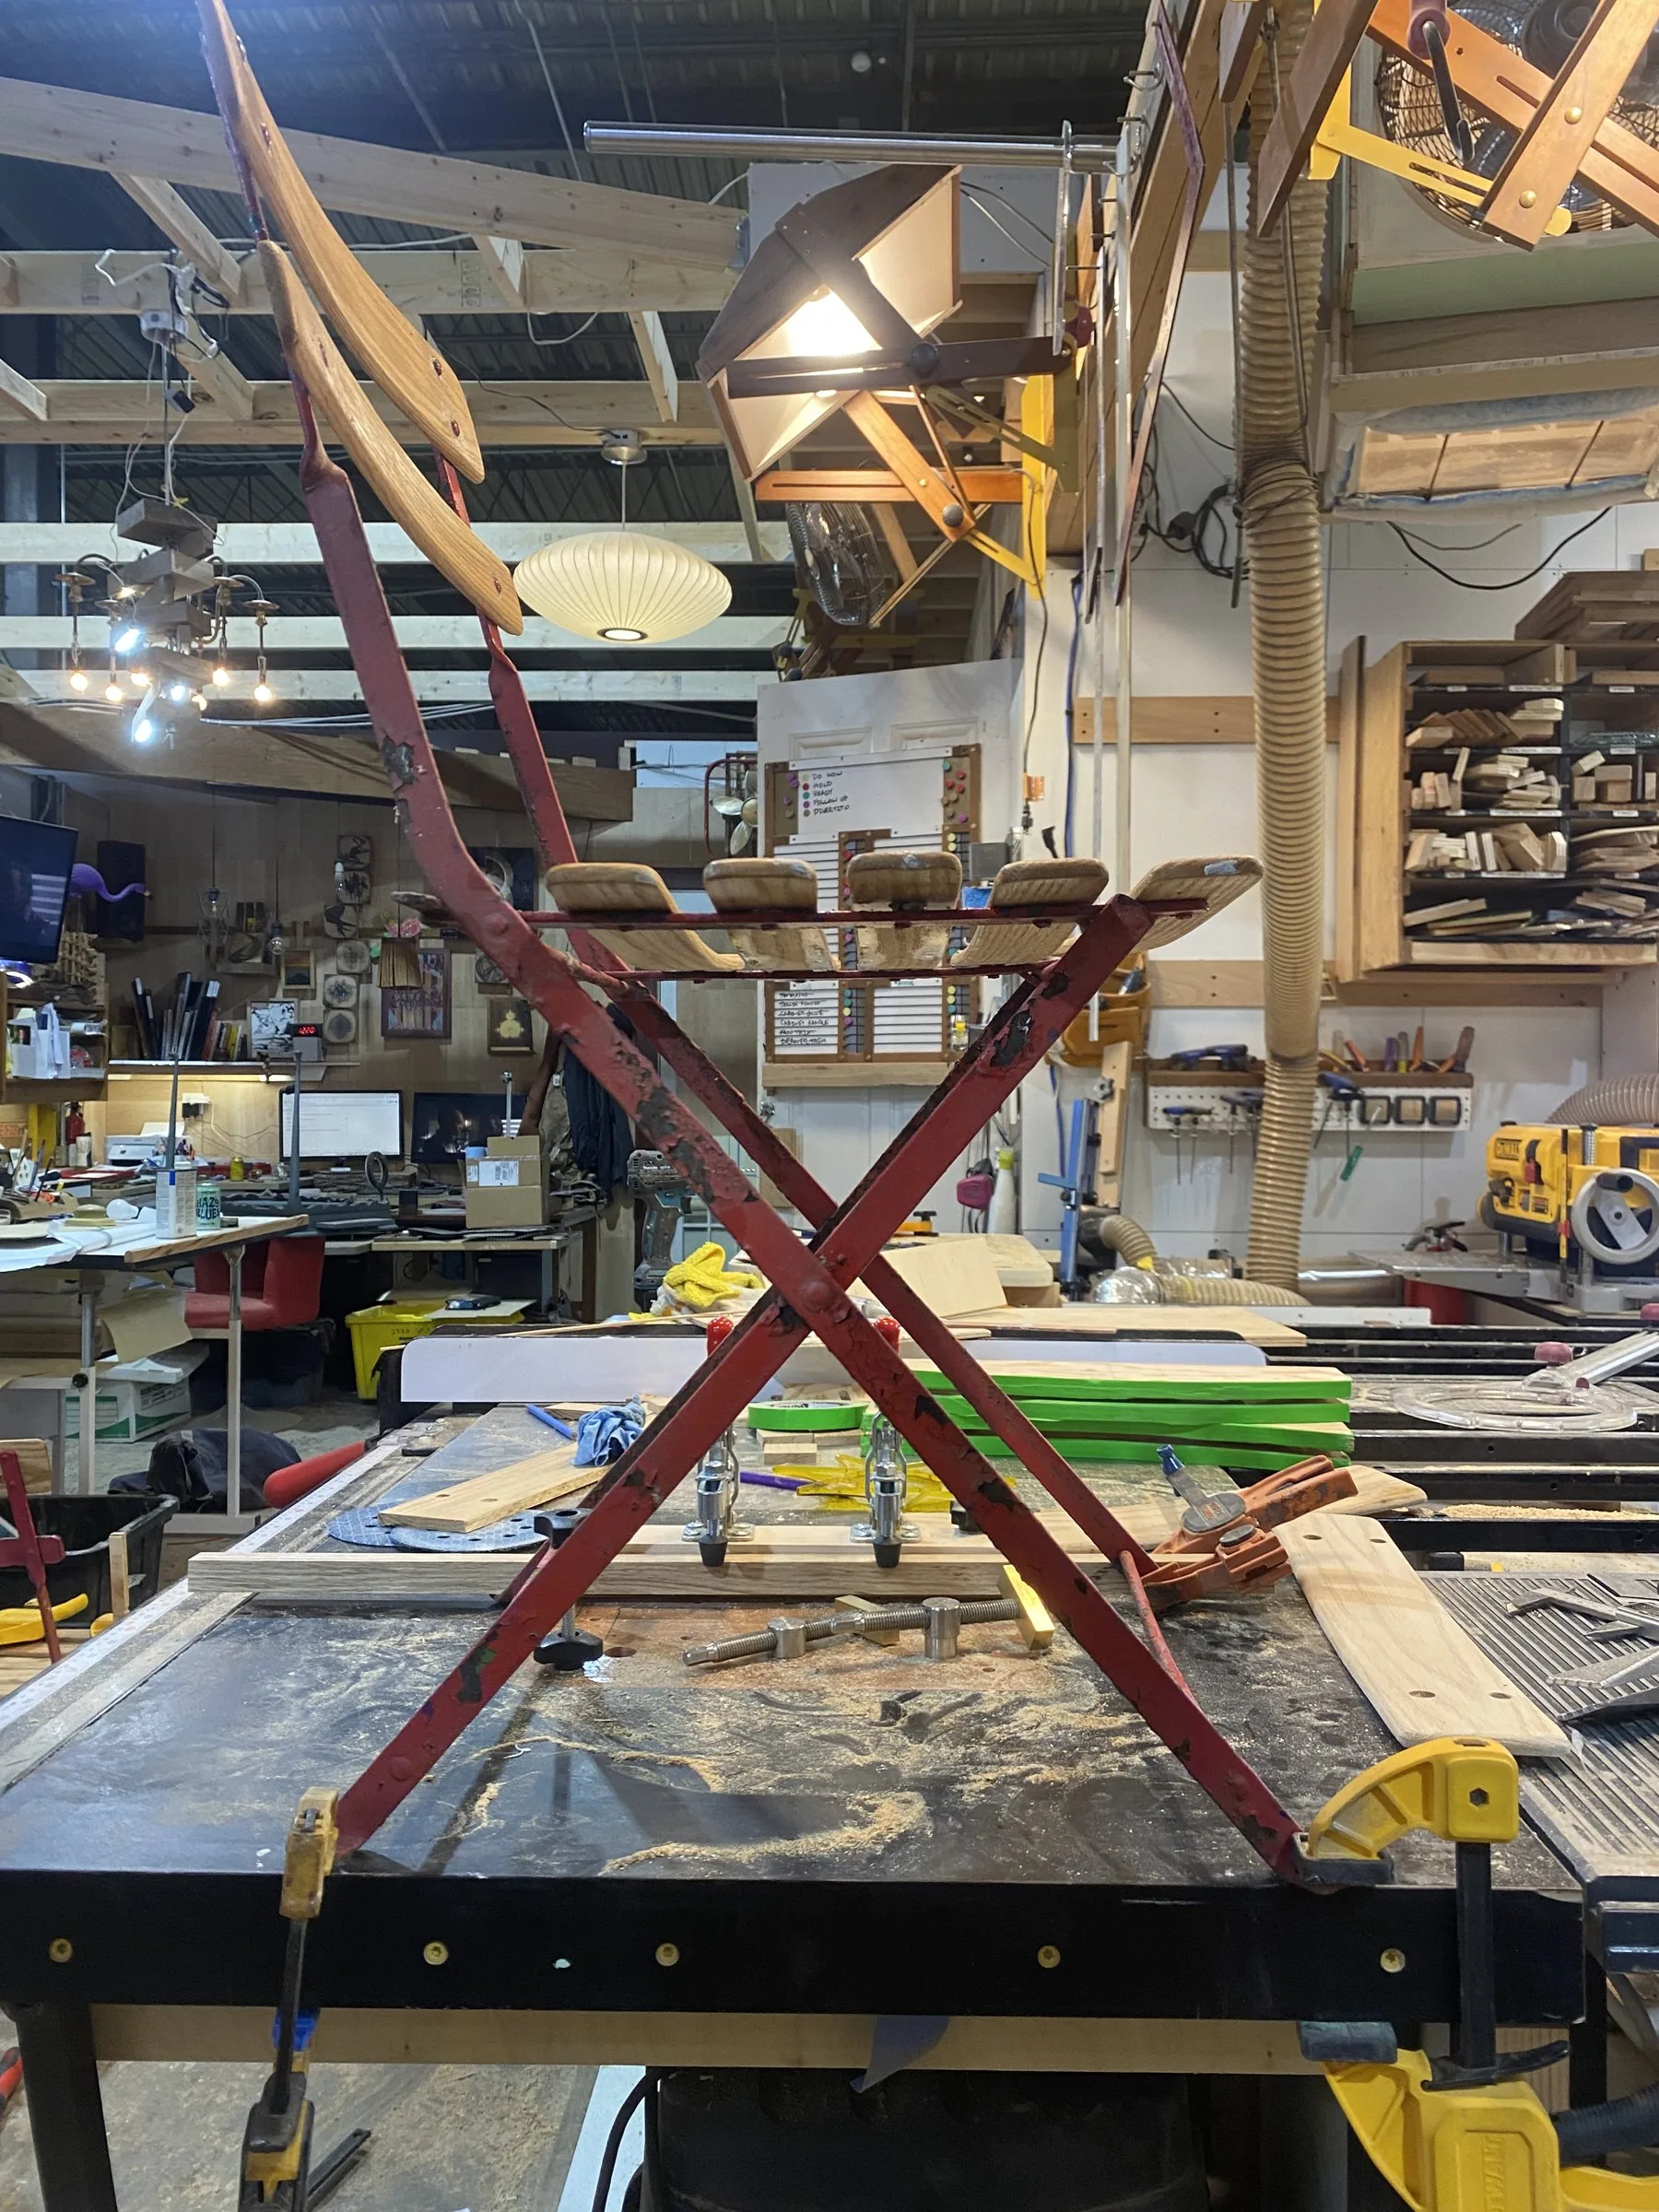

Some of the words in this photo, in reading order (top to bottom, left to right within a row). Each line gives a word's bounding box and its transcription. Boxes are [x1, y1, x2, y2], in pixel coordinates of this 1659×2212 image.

[813, 788, 833, 796] READY
[813, 797, 838, 806] FOLLOW
[196, 1197, 219, 1207] HAZY
